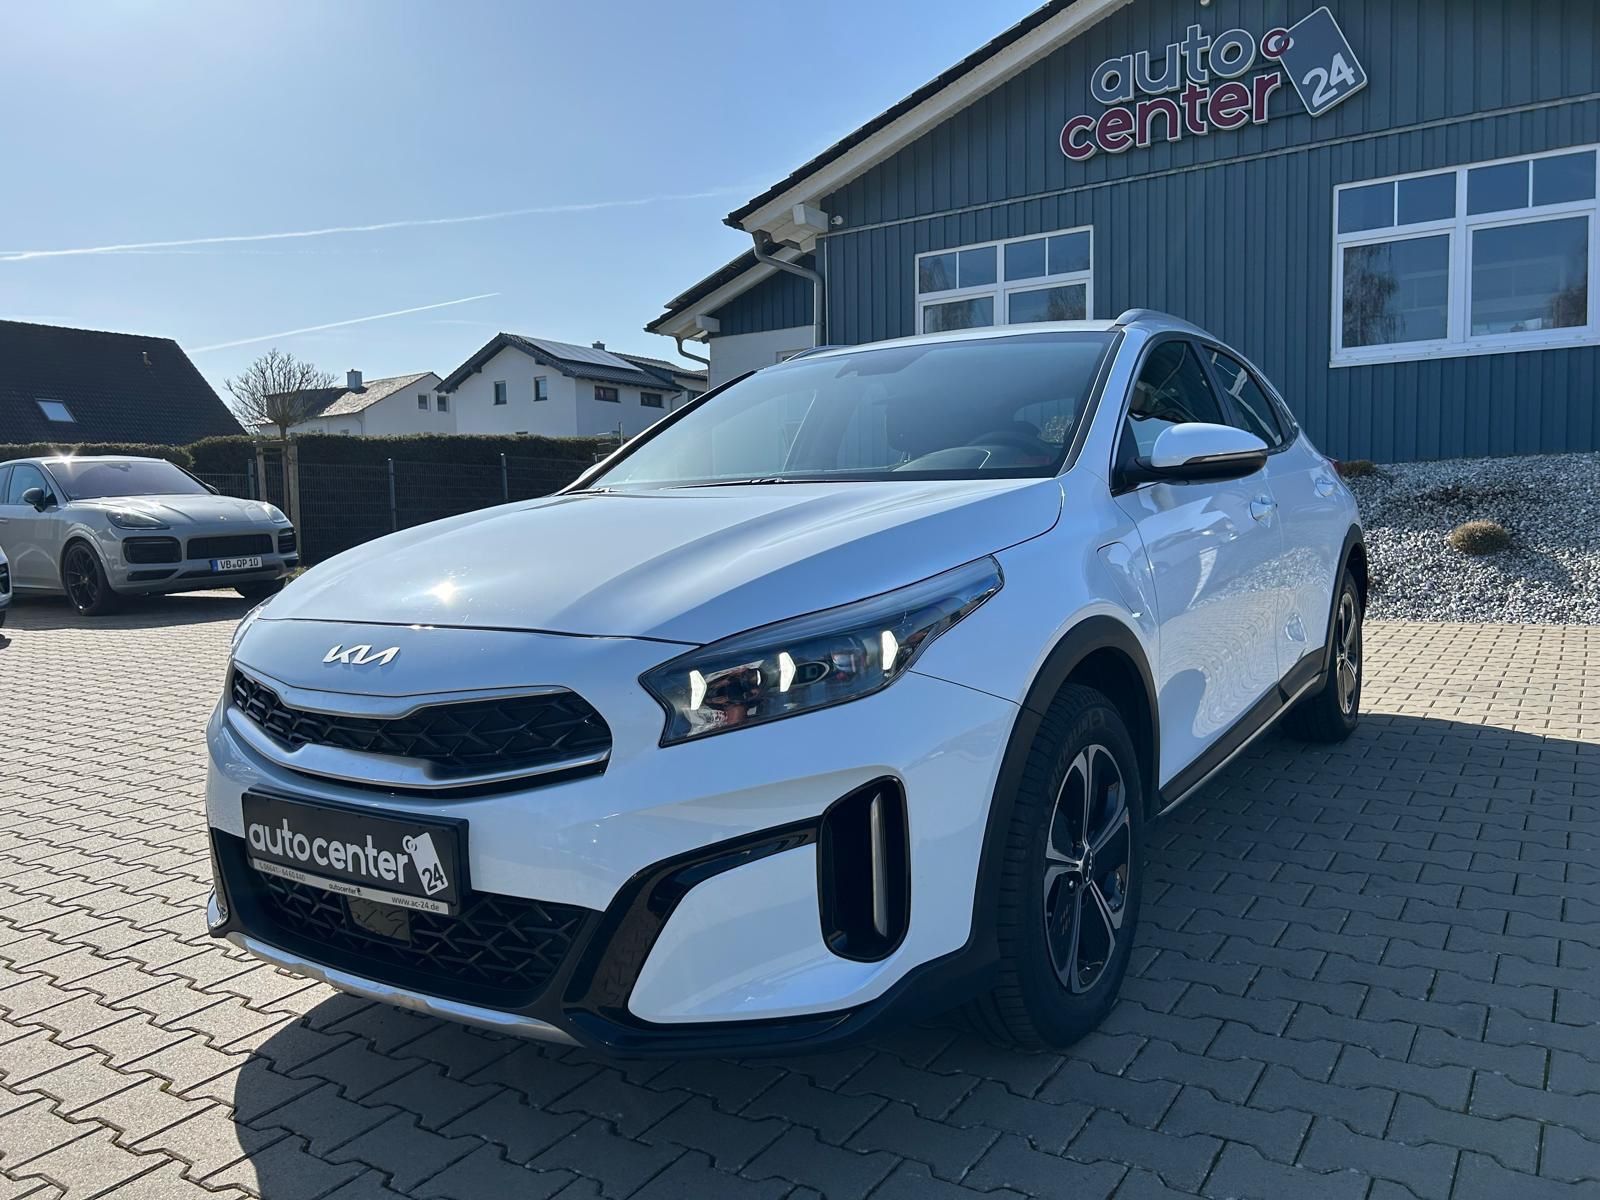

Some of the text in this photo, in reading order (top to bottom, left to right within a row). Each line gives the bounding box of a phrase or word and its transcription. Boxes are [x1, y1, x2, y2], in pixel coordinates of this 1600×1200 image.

[1090, 24, 1257, 106] auto
[1302, 52, 1355, 108] 24
[1059, 71, 1281, 162] center
[322, 643, 401, 667] KIA
[248, 818, 409, 884] autocenter
[421, 862, 445, 892] 24
[391, 896, 440, 912] www.ac-24.de
